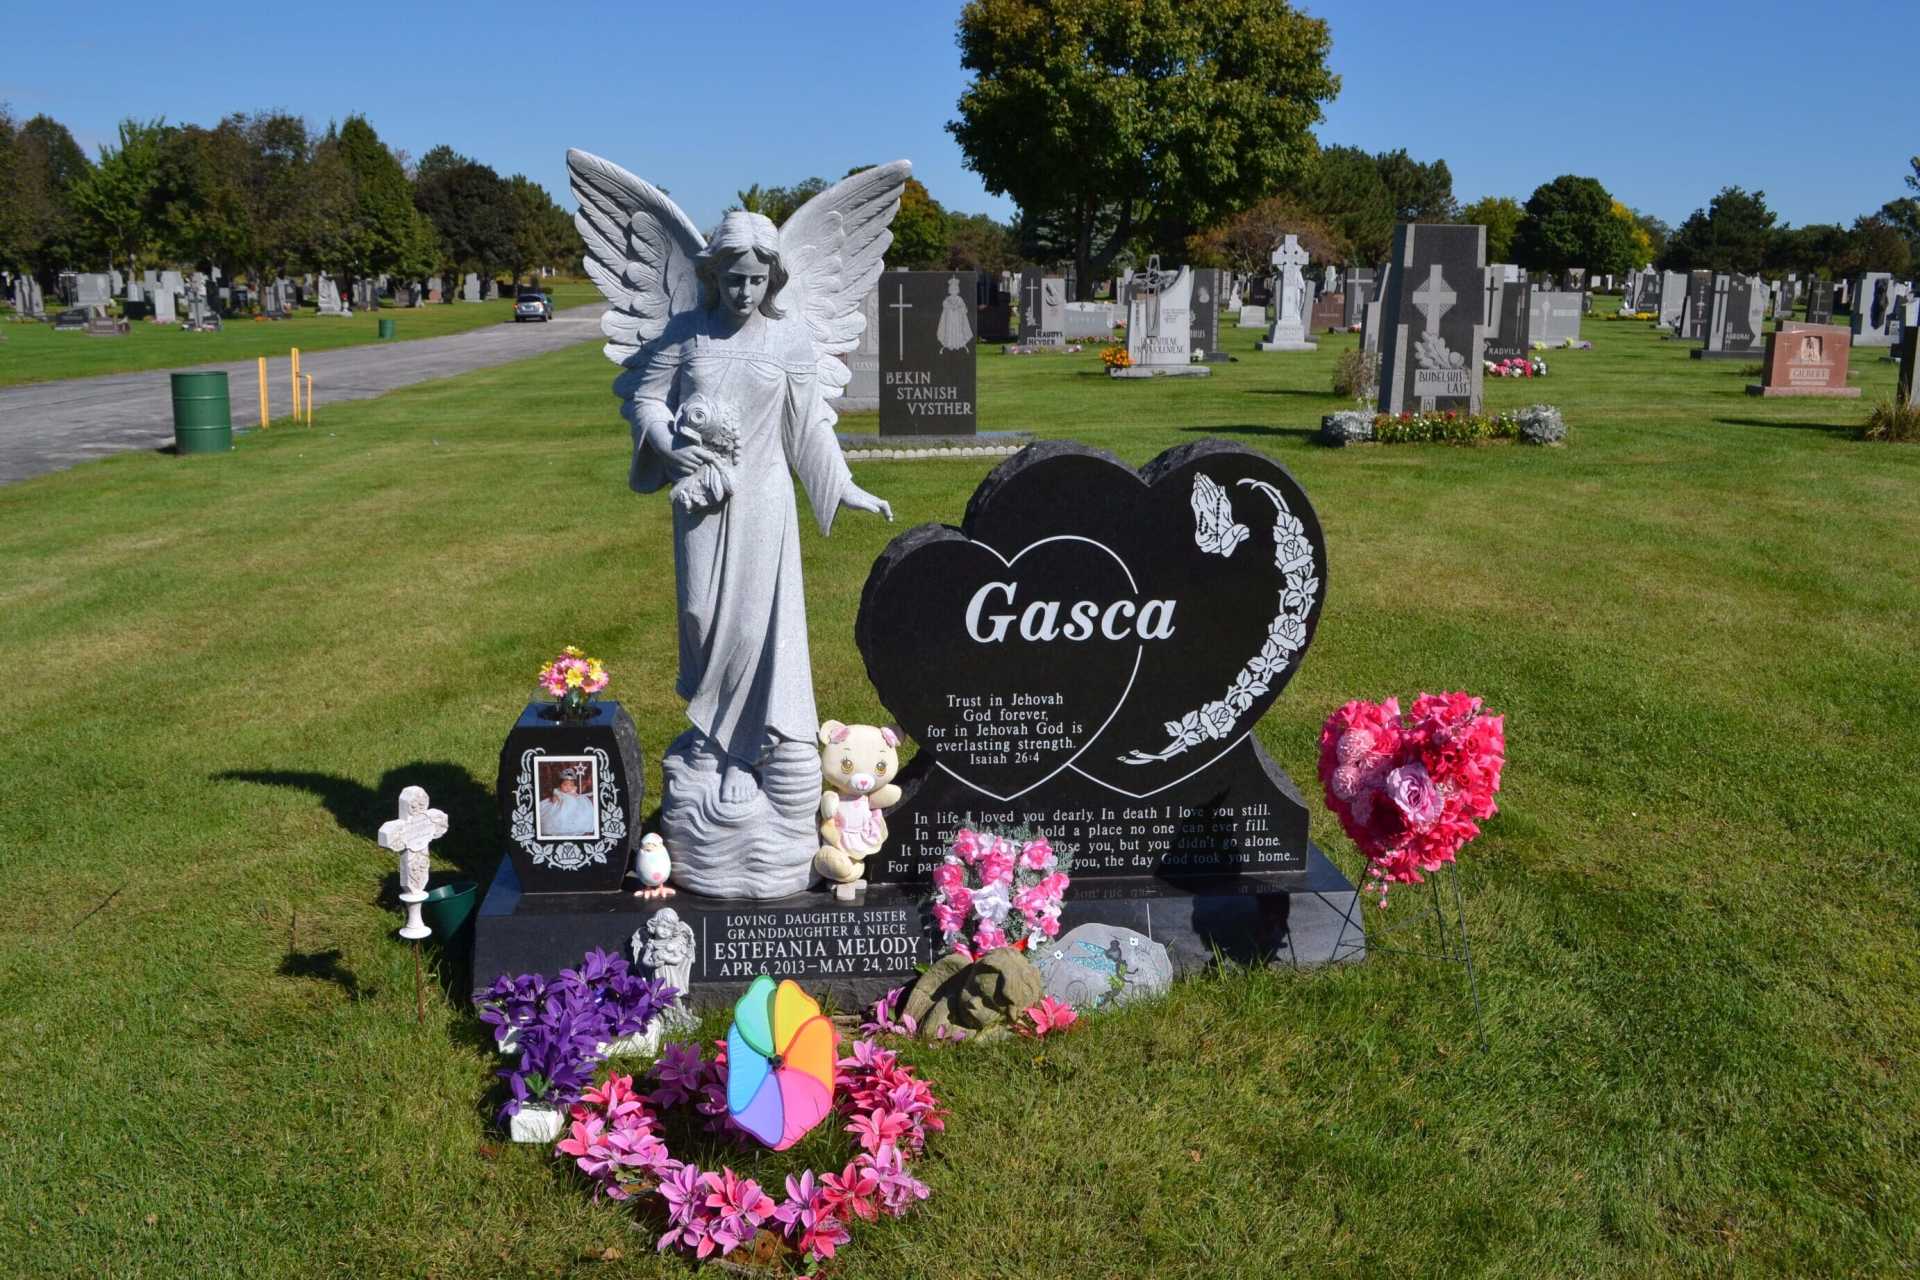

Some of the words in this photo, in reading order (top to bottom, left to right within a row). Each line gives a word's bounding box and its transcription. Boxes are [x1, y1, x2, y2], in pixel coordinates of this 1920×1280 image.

[886, 371, 931, 384] BEKIN
[896, 386, 957, 400] STANISH
[907, 402, 973, 415] VYSTHER
[965, 581, 1177, 643] Gasca
[946, 694, 982, 707] Trust
[990, 694, 1003, 706] in
[1012, 692, 1064, 706] Jehovah
[963, 708, 994, 721] God
[1000, 708, 1049, 722] forever,
[927, 724, 946, 737] for
[954, 724, 968, 736] in
[976, 723, 1028, 736] Jehovah
[1036, 722, 1064, 735] God
[1071, 722, 1083, 734] is
[936, 738, 1011, 752] everlasting
[1017, 737, 1077, 751] strength.
[970, 752, 1008, 765] Isaiah
[1014, 752, 1040, 764] 26:4
[914, 813, 928, 824] In
[937, 812, 959, 824] life
[981, 811, 1014, 823] loved
[1023, 812, 1045, 825] you
[1053, 808, 1094, 822] dearly.
[1101, 808, 1115, 820] In
[1123, 807, 1157, 819] death
[1165, 806, 1171, 818] I
[1178, 806, 1203, 818] love
[1213, 806, 1234, 820] you
[1242, 804, 1271, 817] still.
[915, 828, 929, 840] In
[937, 829, 956, 842] my
[1038, 825, 1065, 837] hold
[1073, 828, 1080, 836] a
[1089, 823, 1123, 837] place
[1130, 824, 1145, 834] no
[1153, 822, 1175, 834] one
[1182, 822, 1204, 833] can
[1211, 821, 1239, 833] ever
[1245, 819, 1269, 832] fill.
[901, 844, 912, 856] It
[1089, 841, 1114, 853] you,
[1120, 839, 1140, 851] but
[1148, 839, 1170, 852] you
[1178, 837, 1215, 849] didn't
[1223, 838, 1237, 850] go
[1245, 835, 1281, 848] alone.
[888, 861, 909, 873] For
[1075, 856, 1100, 869] you,
[1105, 855, 1124, 867] the
[1132, 854, 1154, 868] day
[1162, 852, 1188, 865] God
[1194, 852, 1220, 864] took
[727, 915, 777, 926] LOVING
[785, 911, 861, 924] DAUGHTER,
[863, 911, 907, 922] SISTER
[727, 927, 848, 939] GRANDDAUGHTER
[854, 925, 862, 935] &
[867, 924, 907, 935] NIECE
[715, 940, 827, 960] ESTEFANIA
[838, 937, 920, 956] MELODY
[720, 962, 757, 976] APR.
[760, 962, 770, 975] 6,
[864, 957, 882, 972] 24,
[887, 956, 918, 970] 2013
